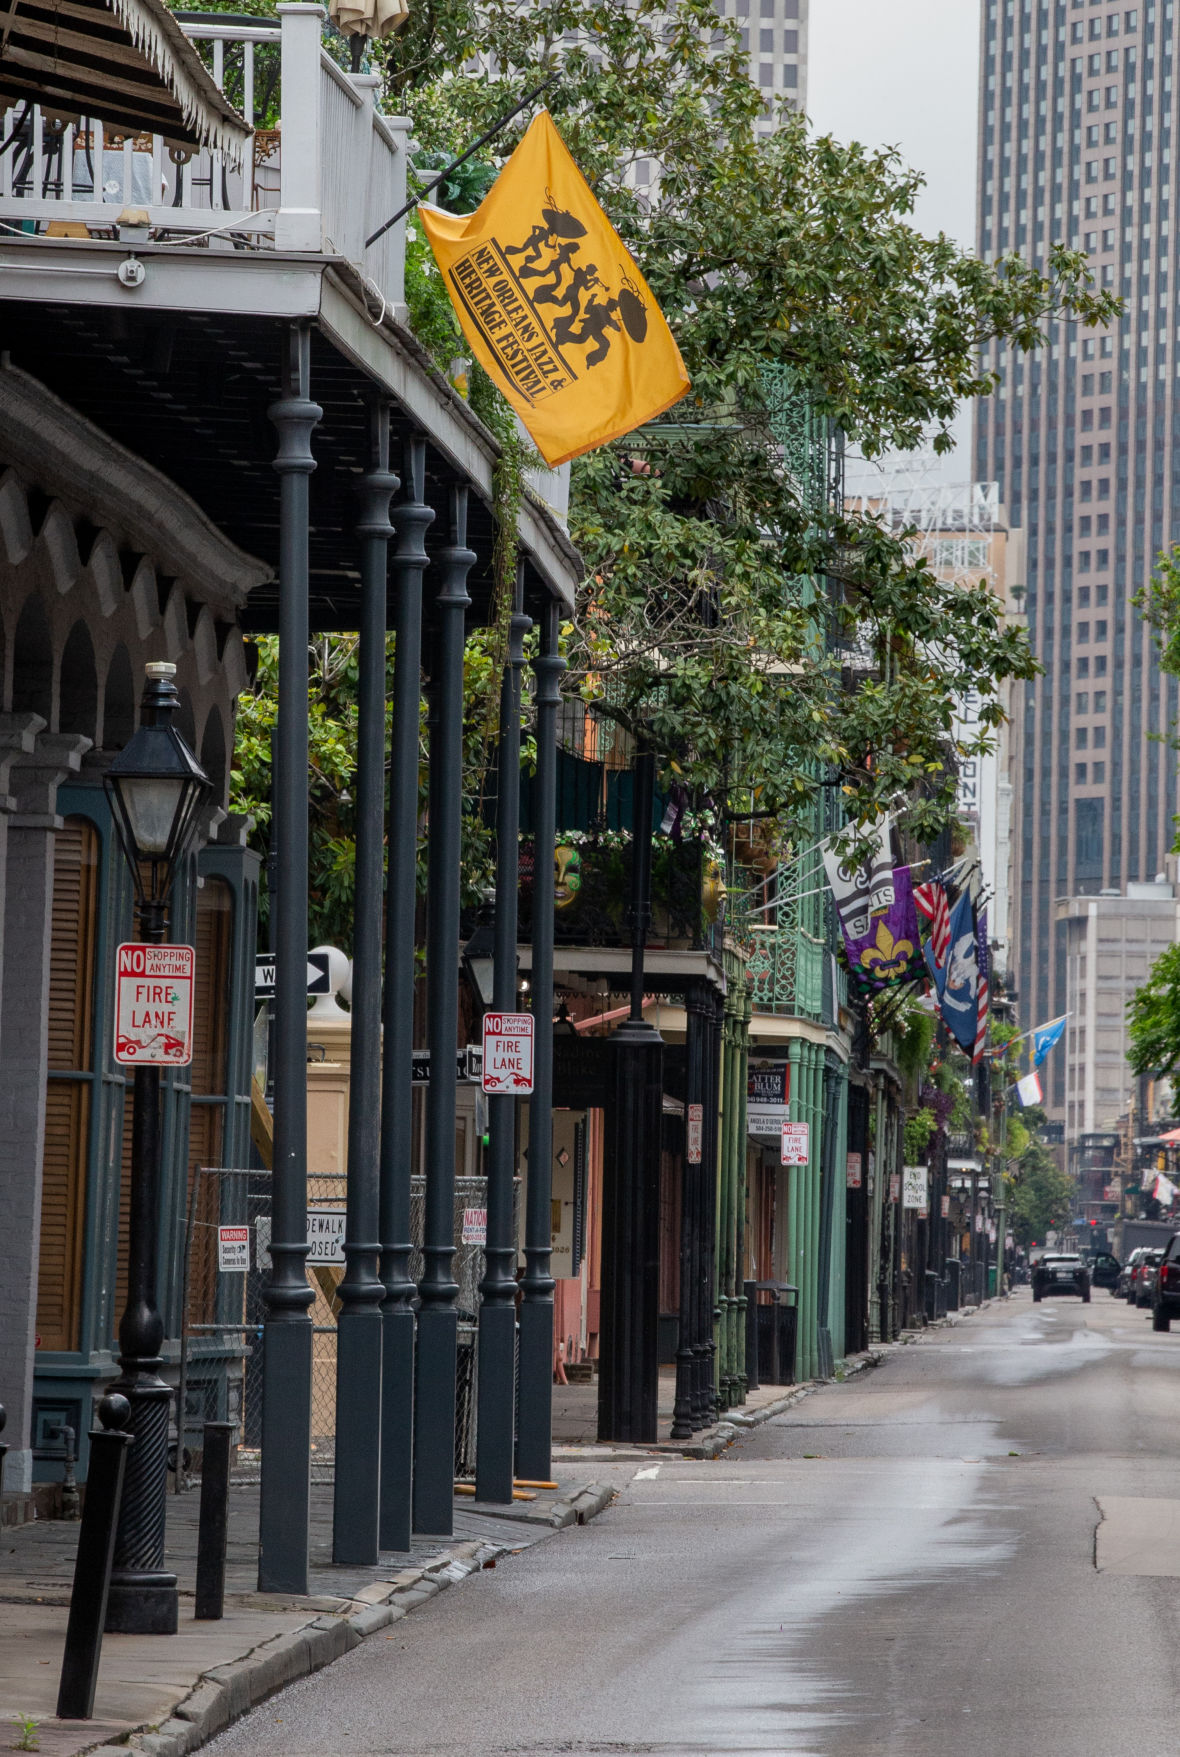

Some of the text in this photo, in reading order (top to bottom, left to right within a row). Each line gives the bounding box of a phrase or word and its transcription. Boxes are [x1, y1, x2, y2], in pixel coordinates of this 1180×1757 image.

[472, 246, 567, 391] NEW ORLEANS JAZZ &
[454, 257, 549, 399] HERITAGE FESTIVAL
[120, 949, 191, 973] NO STOPPING
[149, 963, 188, 974] ANYTIME
[135, 985, 174, 1004] FIRE
[131, 1010, 177, 1029] LANE
[485, 1017, 531, 1033] NO STOPPING
[495, 1040, 521, 1053] FIRE
[493, 1057, 523, 1070] LANE
[754, 1082, 782, 1092] BLUM
[783, 1124, 792, 1133] NO
[788, 1136, 802, 1145] FIRE
[787, 1145, 803, 1154] LANE
[907, 1194, 922, 1204] ZONE
[306, 1218, 343, 1234] DEWALK
[221, 1230, 247, 1241] WARNING
[308, 1240, 336, 1257] OSED
